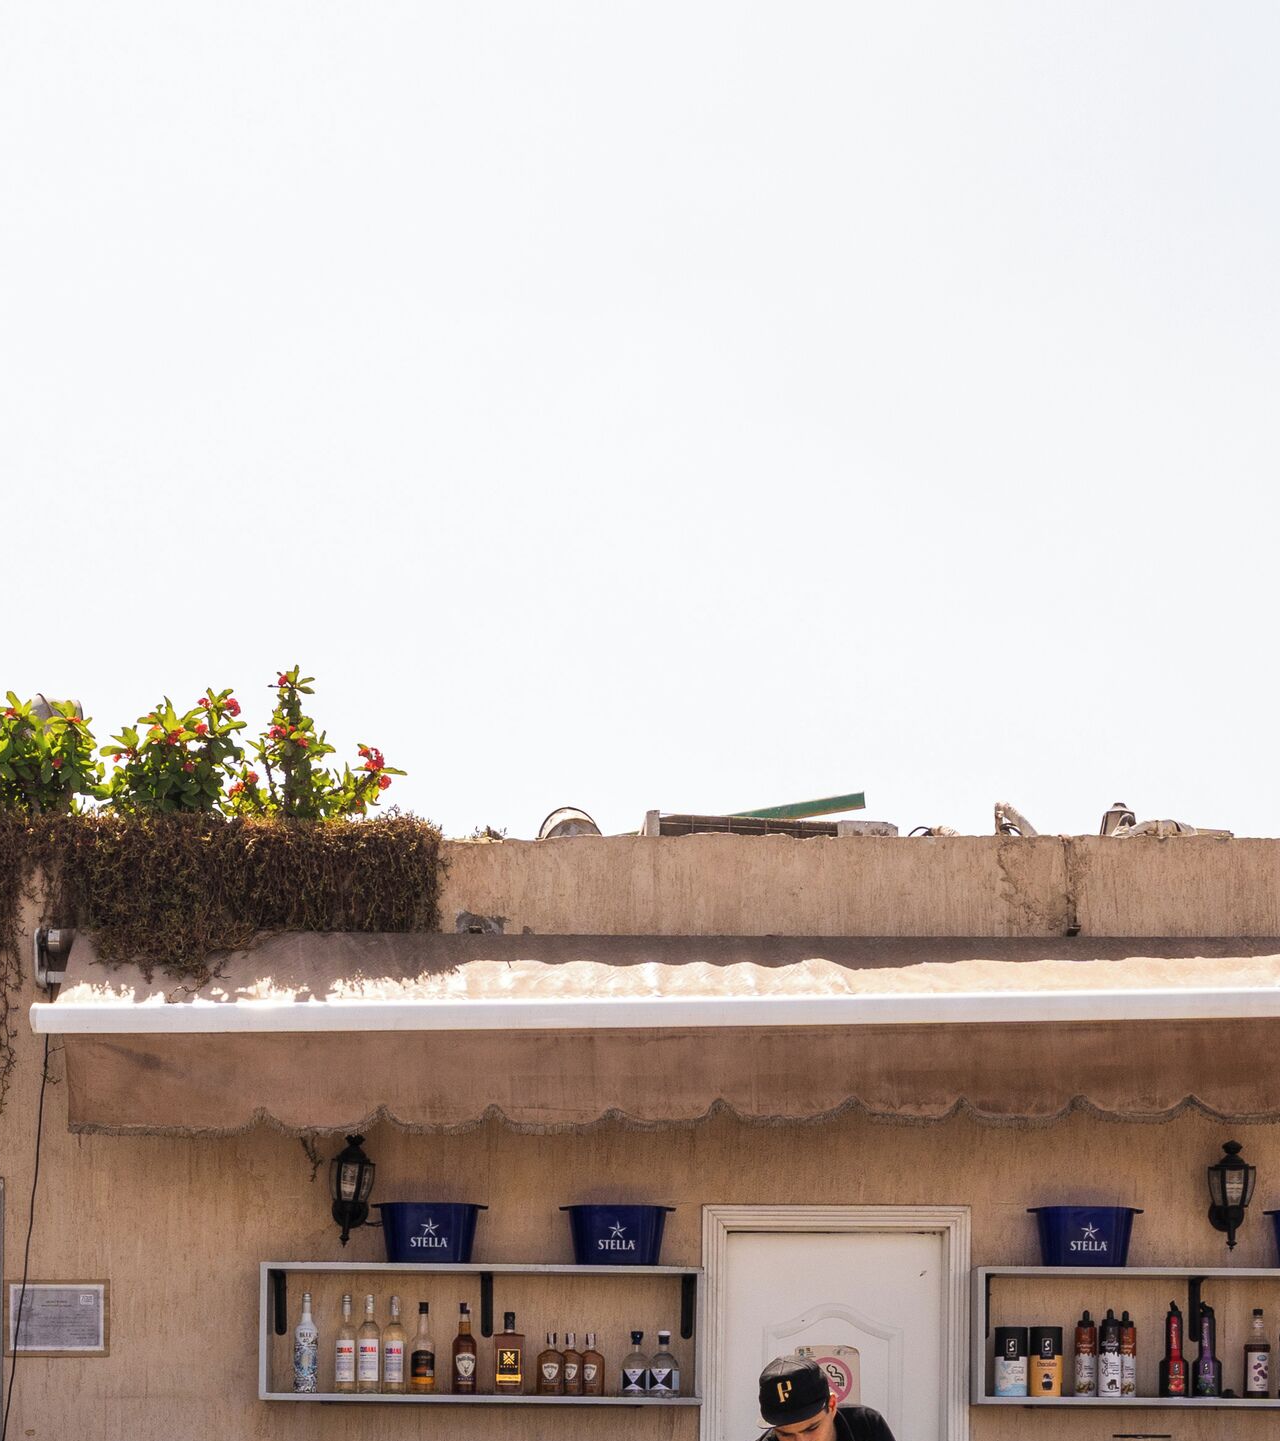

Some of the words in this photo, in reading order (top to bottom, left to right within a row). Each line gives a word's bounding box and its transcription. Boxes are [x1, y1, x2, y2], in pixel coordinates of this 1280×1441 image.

[410, 1236, 448, 1248] STELLA
[597, 1239, 636, 1250] STELLA
[1069, 1240, 1108, 1251] STELLA
